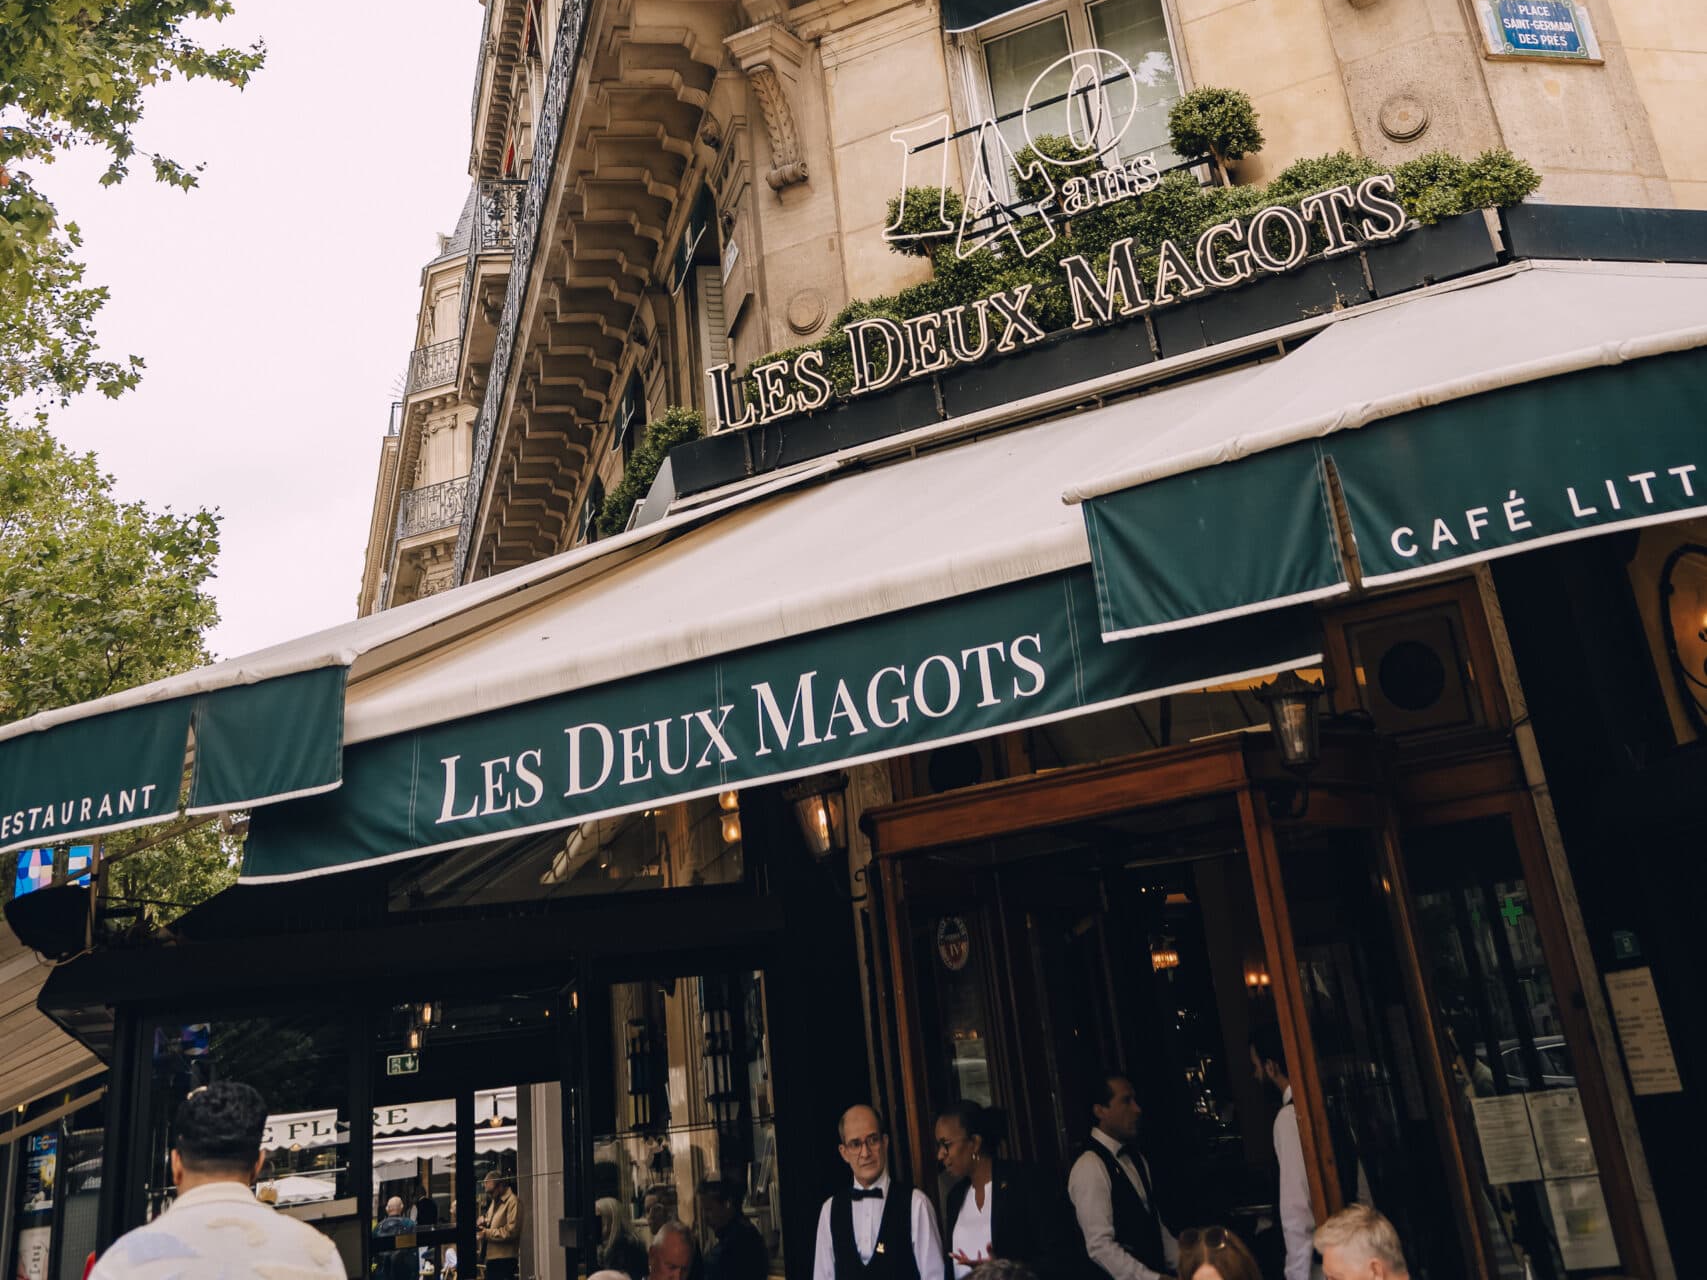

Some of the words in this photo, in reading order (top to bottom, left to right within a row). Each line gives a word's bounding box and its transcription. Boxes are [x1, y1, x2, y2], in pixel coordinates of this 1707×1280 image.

[1503, 18, 1574, 32] SAINT-GERMAIN
[1518, 5, 1550, 17] PLACE
[1518, 33, 1539, 45] DES
[1541, 33, 1568, 46] PRÉS
[882, 48, 1138, 259] 140
[1062, 151, 1161, 215] ans
[705, 349, 832, 436] LES
[843, 284, 1045, 396] DEUX
[1060, 173, 1406, 330] MAGOTS
[1390, 489, 1532, 557] CAFÉ
[1567, 464, 1697, 517] LITT
[435, 749, 544, 824] LES
[563, 704, 738, 798] DEUX
[751, 632, 1046, 757] MAGOTS
[0, 784, 156, 839] ESTAURANT
[288, 1107, 409, 1140] FLRE
